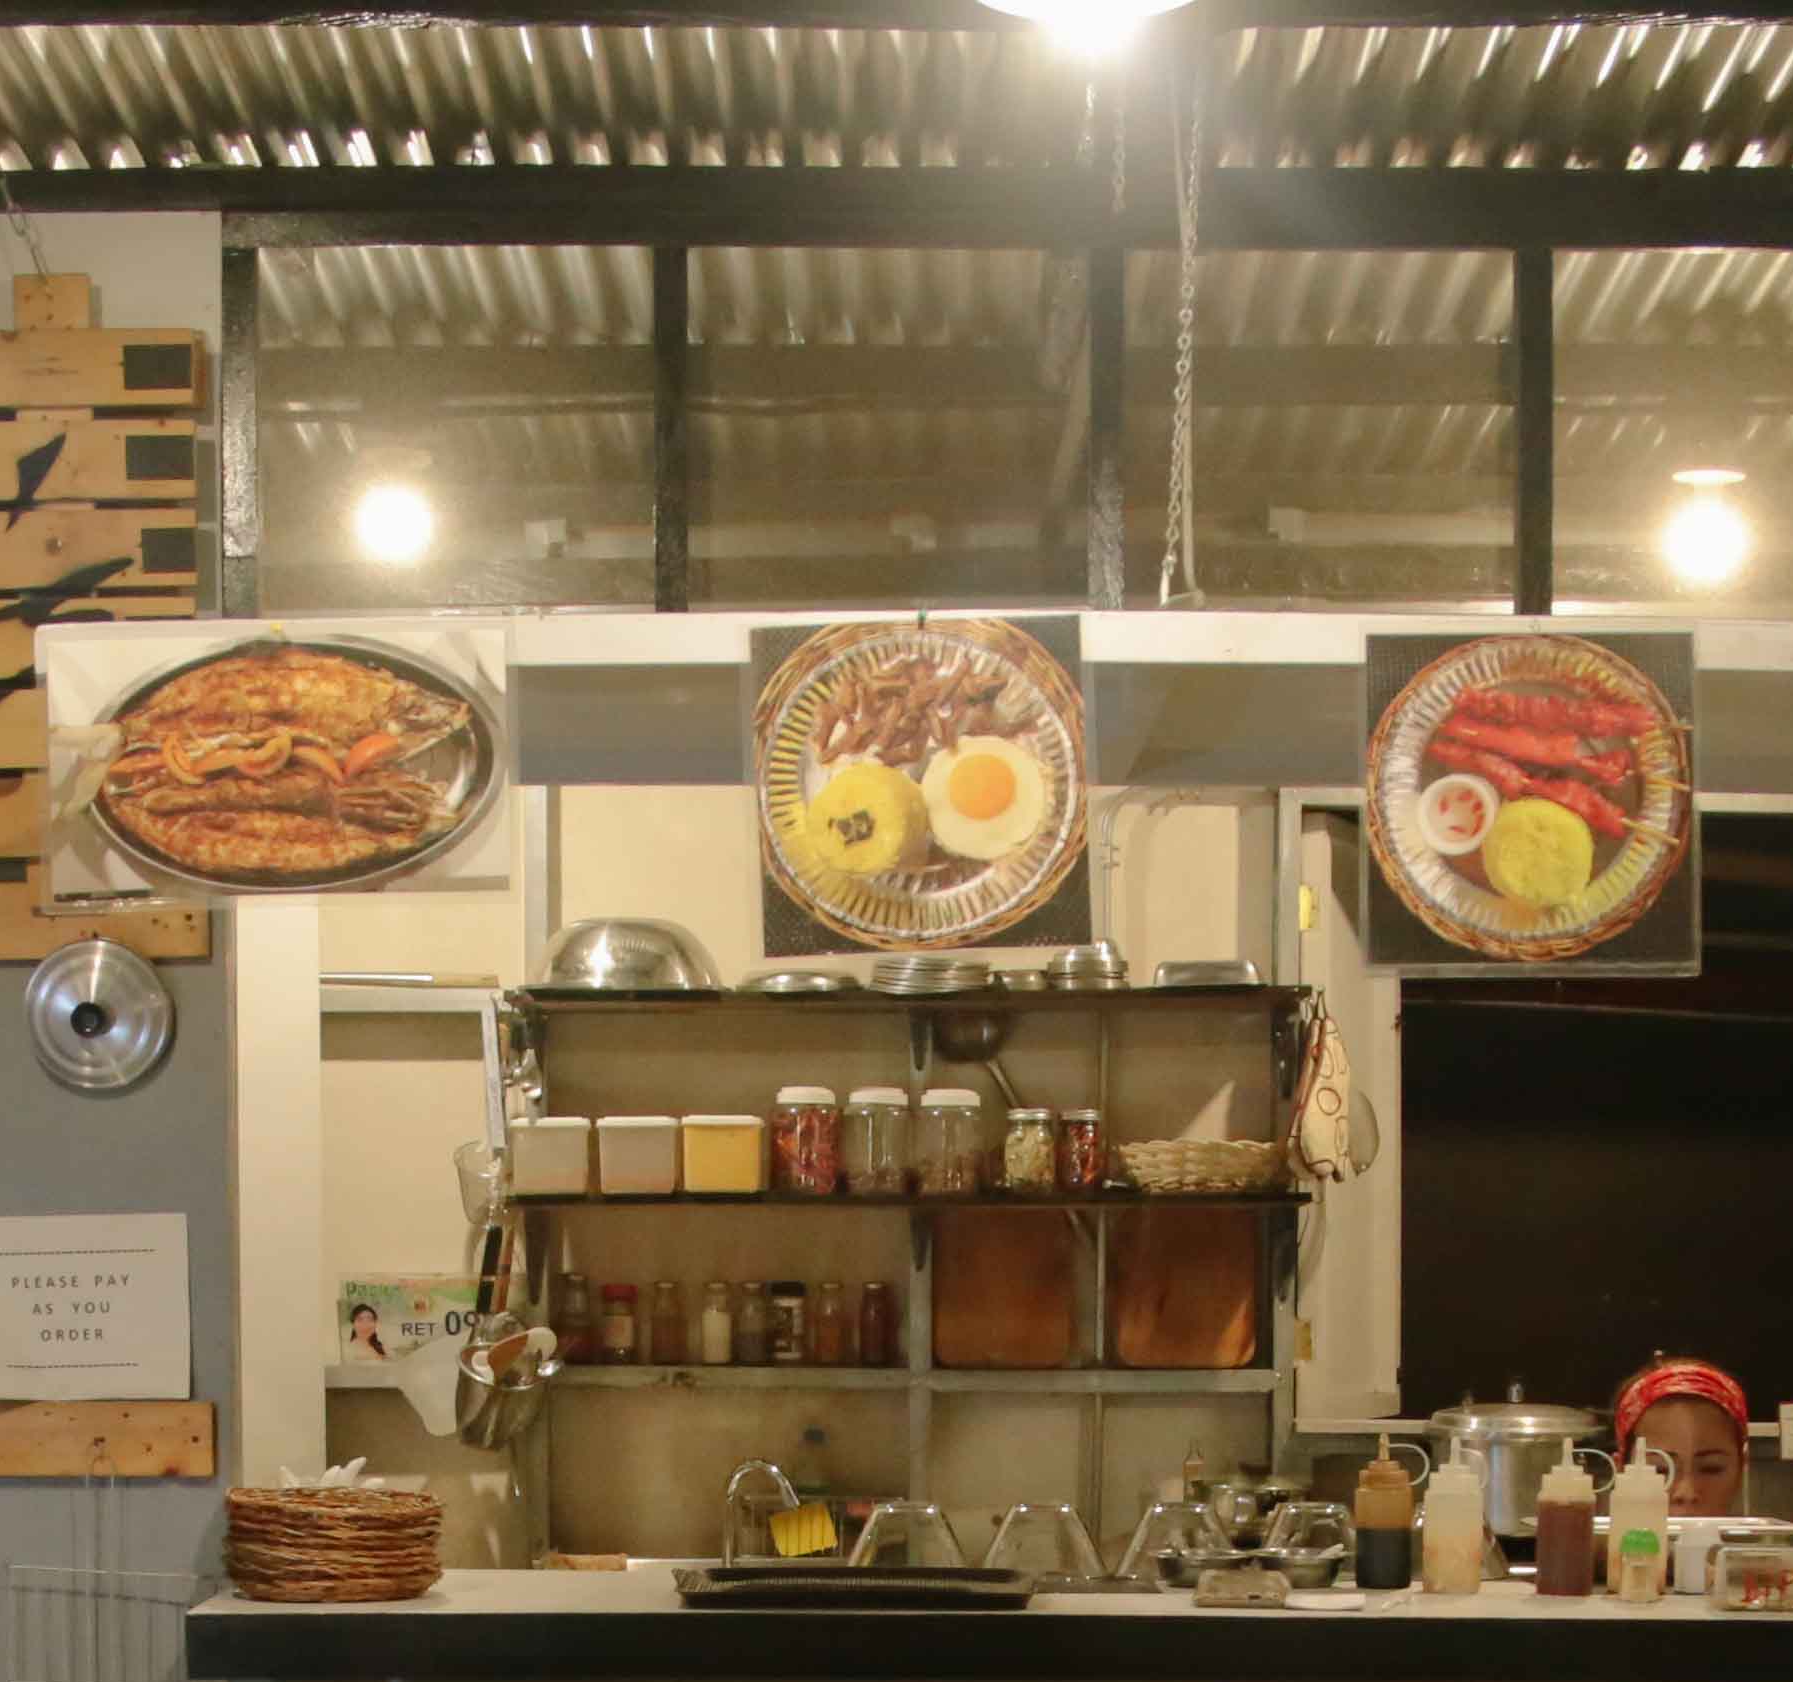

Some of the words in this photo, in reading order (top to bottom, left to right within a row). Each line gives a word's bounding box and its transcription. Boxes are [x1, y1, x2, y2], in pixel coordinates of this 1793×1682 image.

[11, 1275, 79, 1289] PLEASE
[94, 1274, 129, 1288] PAY
[32, 1302, 54, 1315] AS
[72, 1300, 111, 1314] YOU
[40, 1328, 104, 1342] ORDER
[401, 1322, 437, 1337] RET
